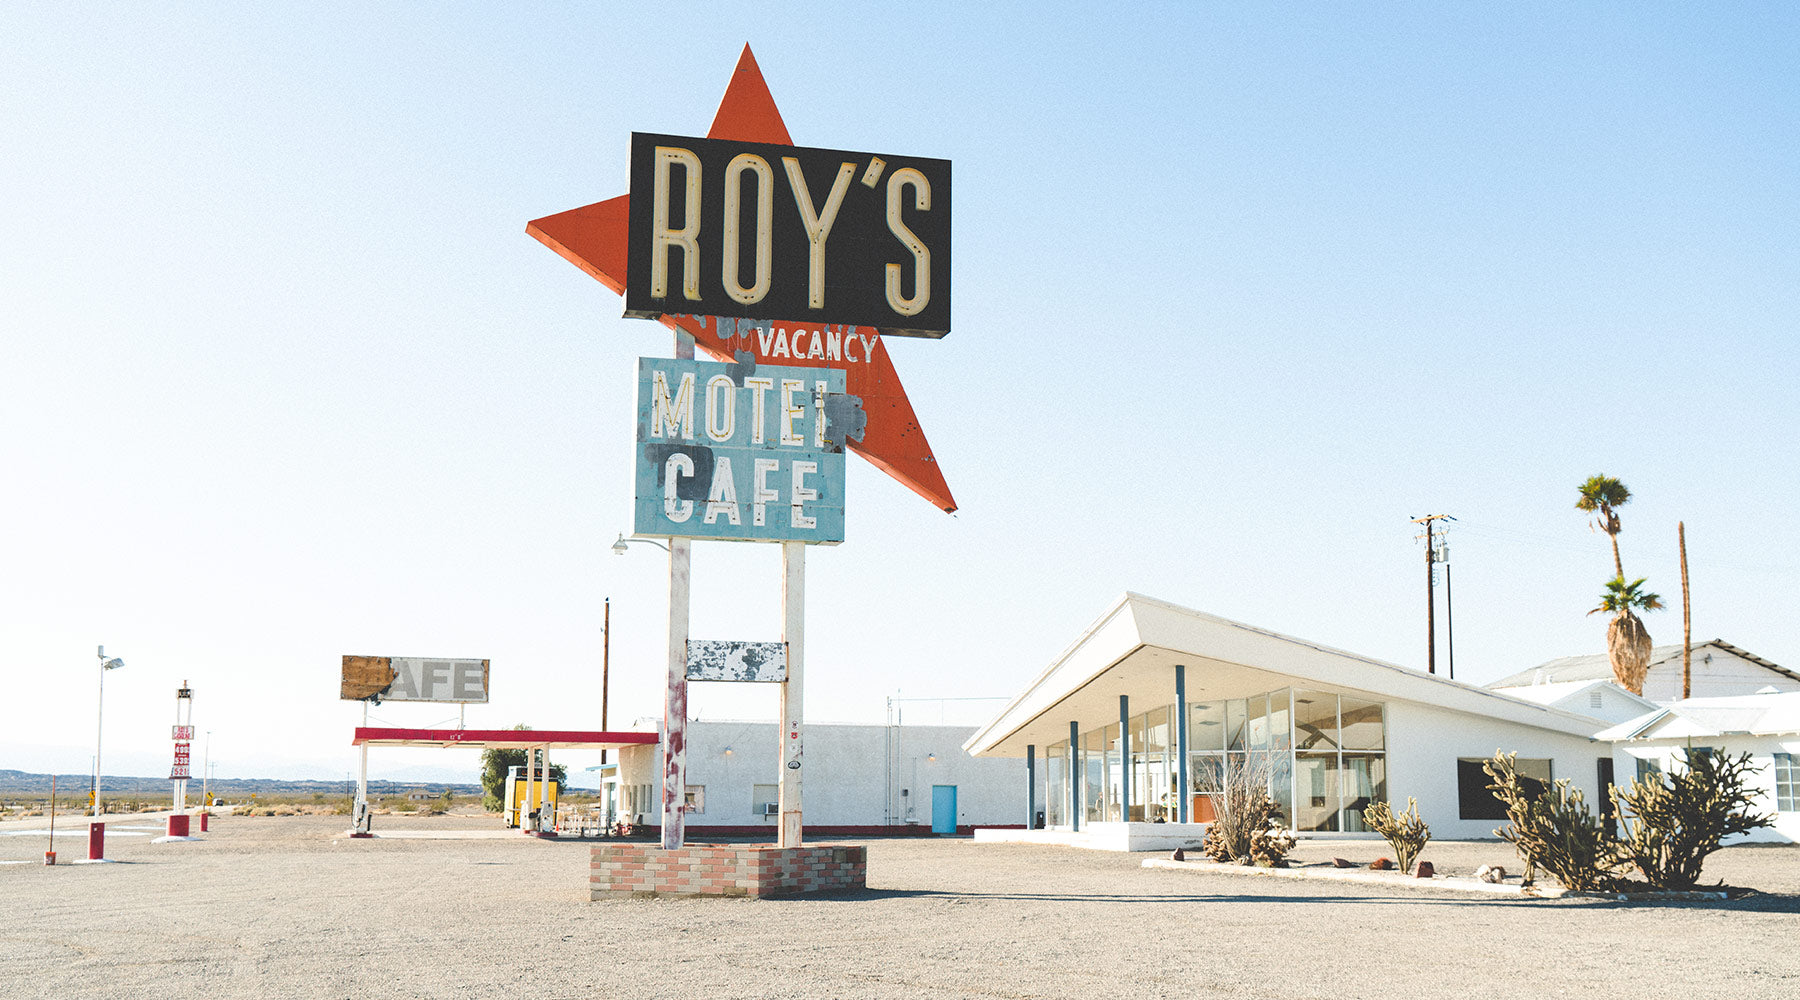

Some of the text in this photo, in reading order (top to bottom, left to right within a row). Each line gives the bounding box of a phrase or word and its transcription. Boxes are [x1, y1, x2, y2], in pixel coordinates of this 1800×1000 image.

[650, 145, 932, 317] ROY'S
[756, 326, 879, 363] VACANCY
[663, 452, 818, 529] CAFE
